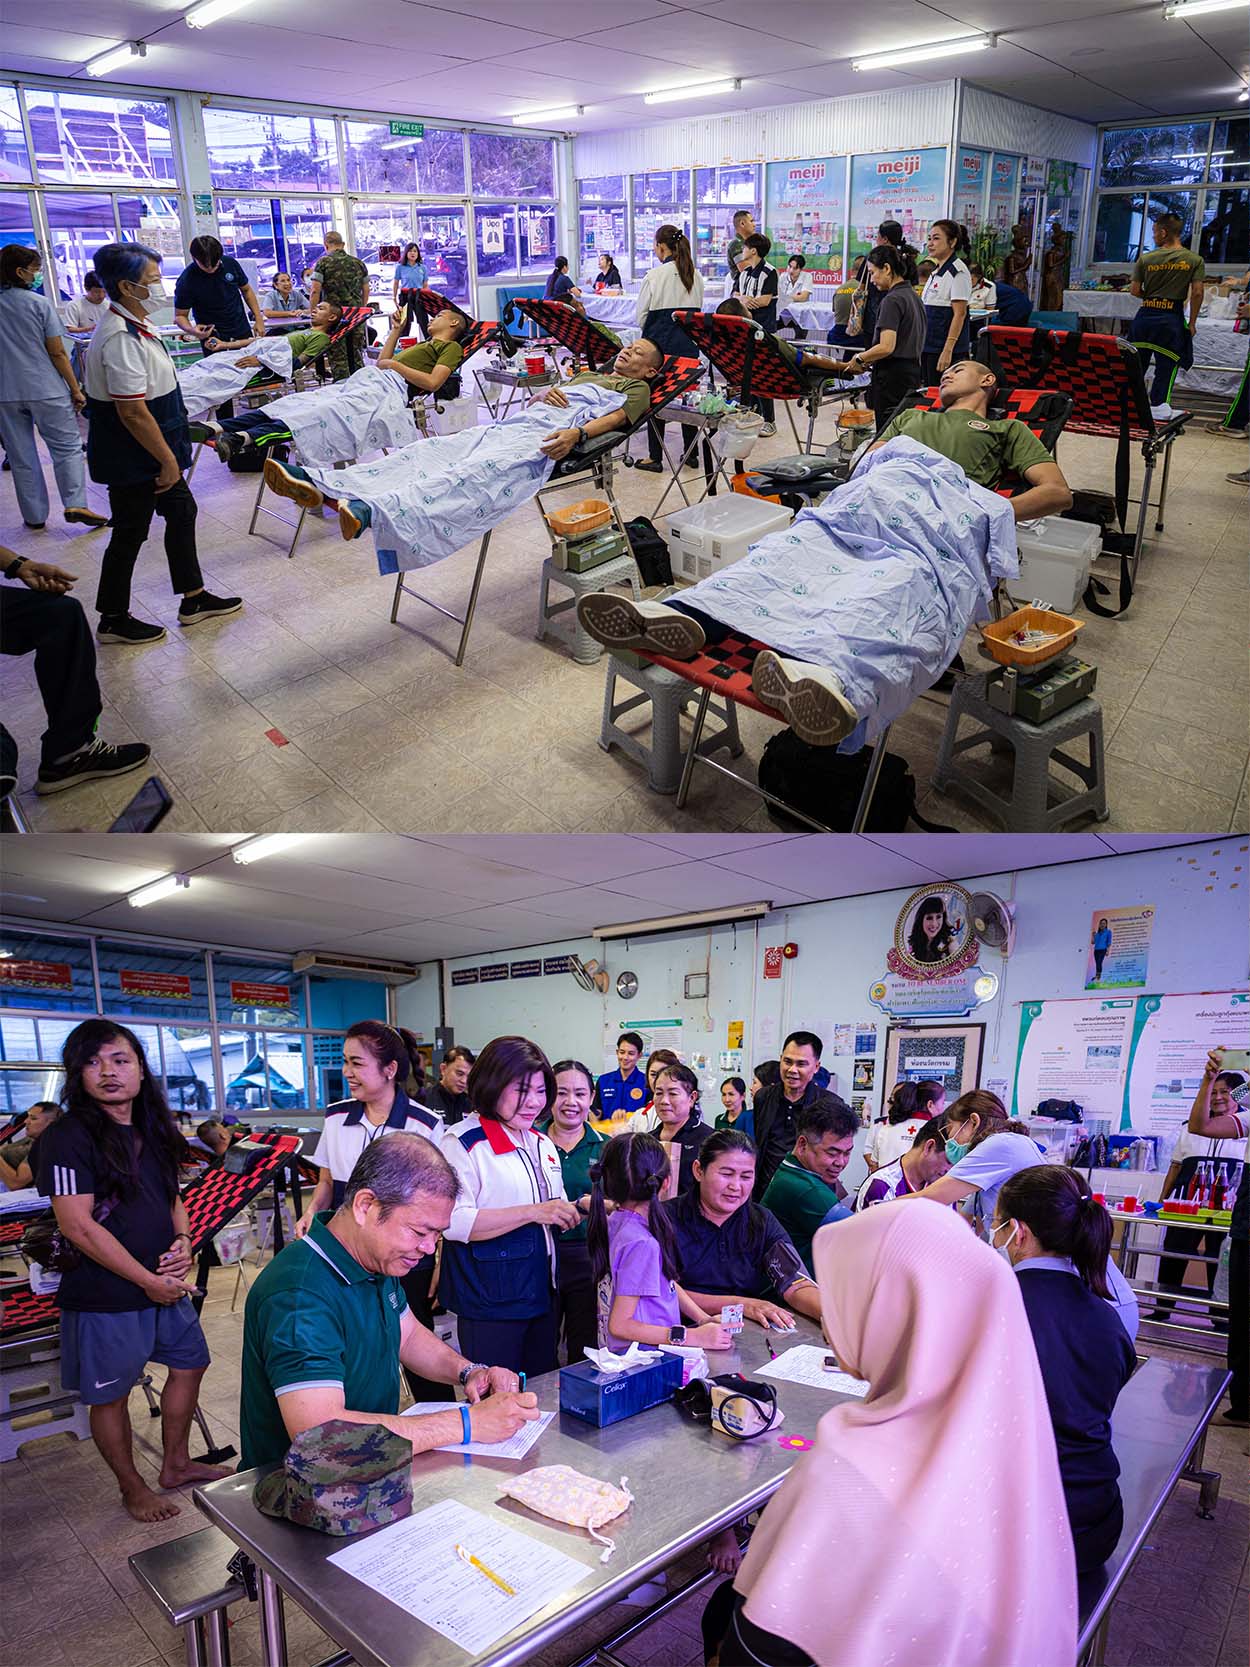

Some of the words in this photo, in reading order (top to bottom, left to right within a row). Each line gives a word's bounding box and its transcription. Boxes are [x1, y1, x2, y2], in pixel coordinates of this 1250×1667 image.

[878, 156, 920, 174] meiji
[963, 155, 980, 172] meiji
[997, 160, 1012, 175] meiji
[789, 164, 825, 181] meiji
[911, 1058, 950, 1066] ห้องนวัตกรรม
